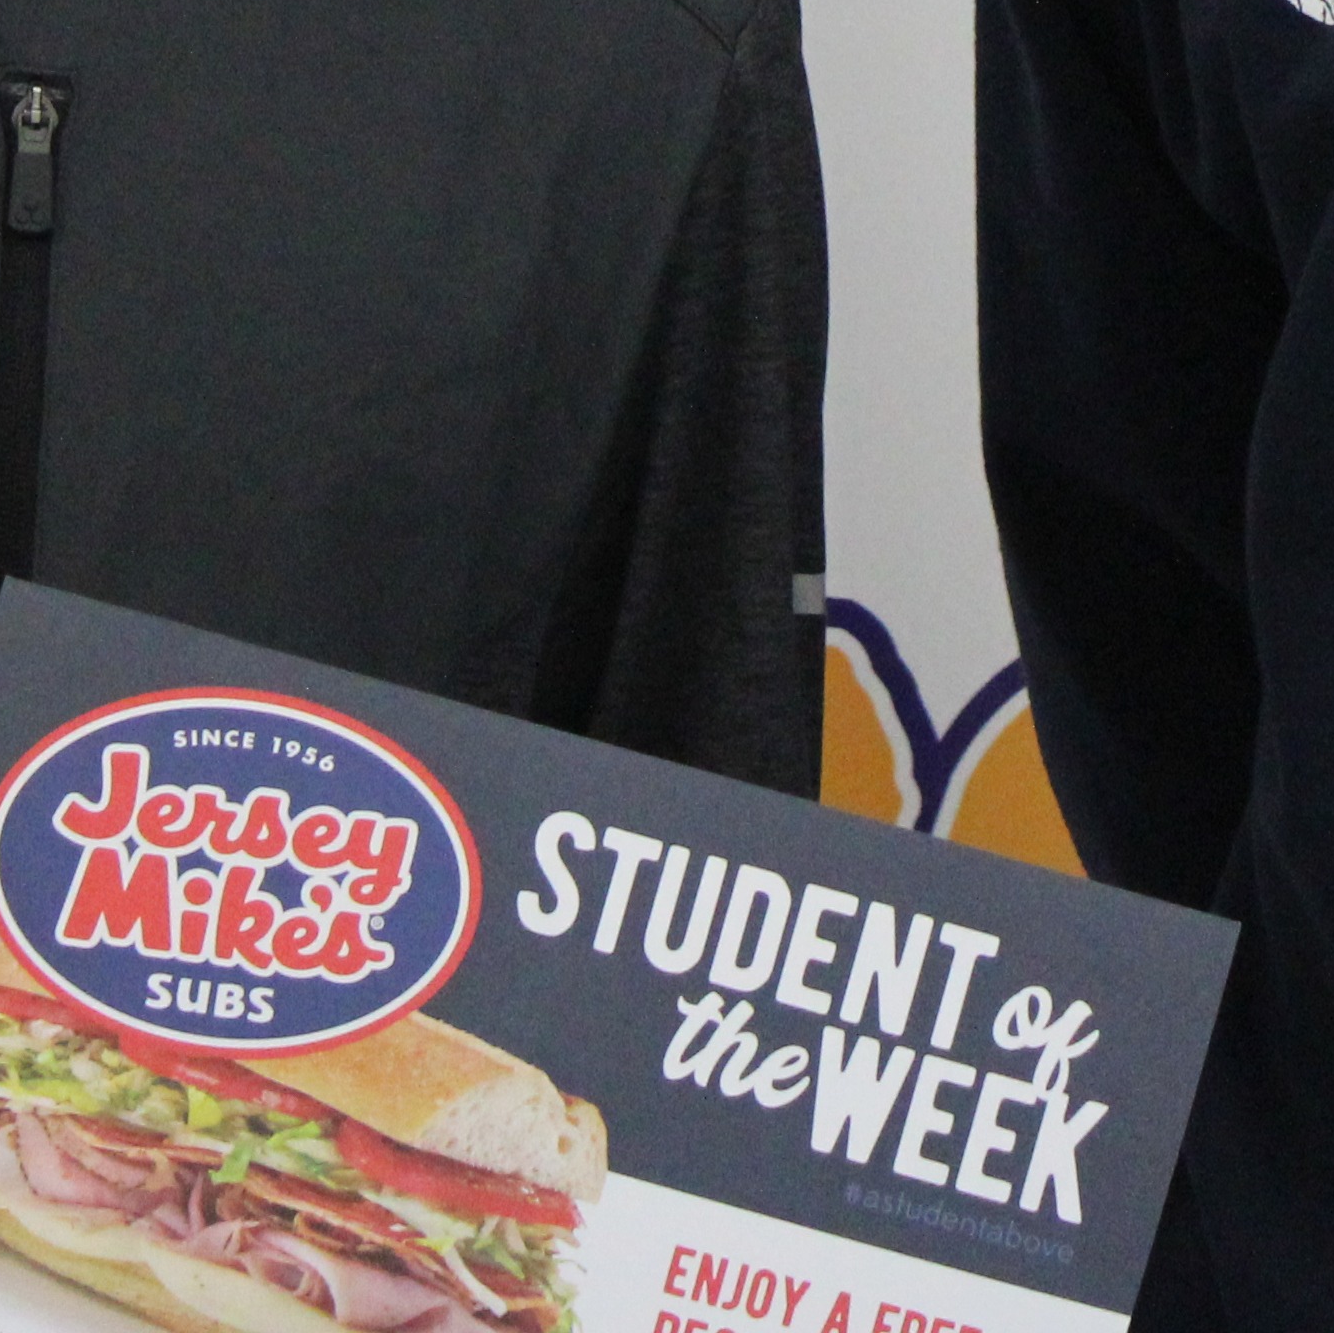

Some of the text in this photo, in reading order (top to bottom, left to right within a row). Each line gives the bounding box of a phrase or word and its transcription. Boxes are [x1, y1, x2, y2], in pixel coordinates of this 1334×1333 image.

[172, 729, 336, 773] SINCE 1956
[53, 743, 419, 907] Jersey
[55, 844, 394, 984] Mike's
[516, 810, 1101, 1104] STUDENT of
[145, 971, 276, 1023] SUBS
[661, 990, 1110, 1226] the WEEK
[663, 1245, 811, 1328] ENJOY
[818, 1291, 852, 1333] A
